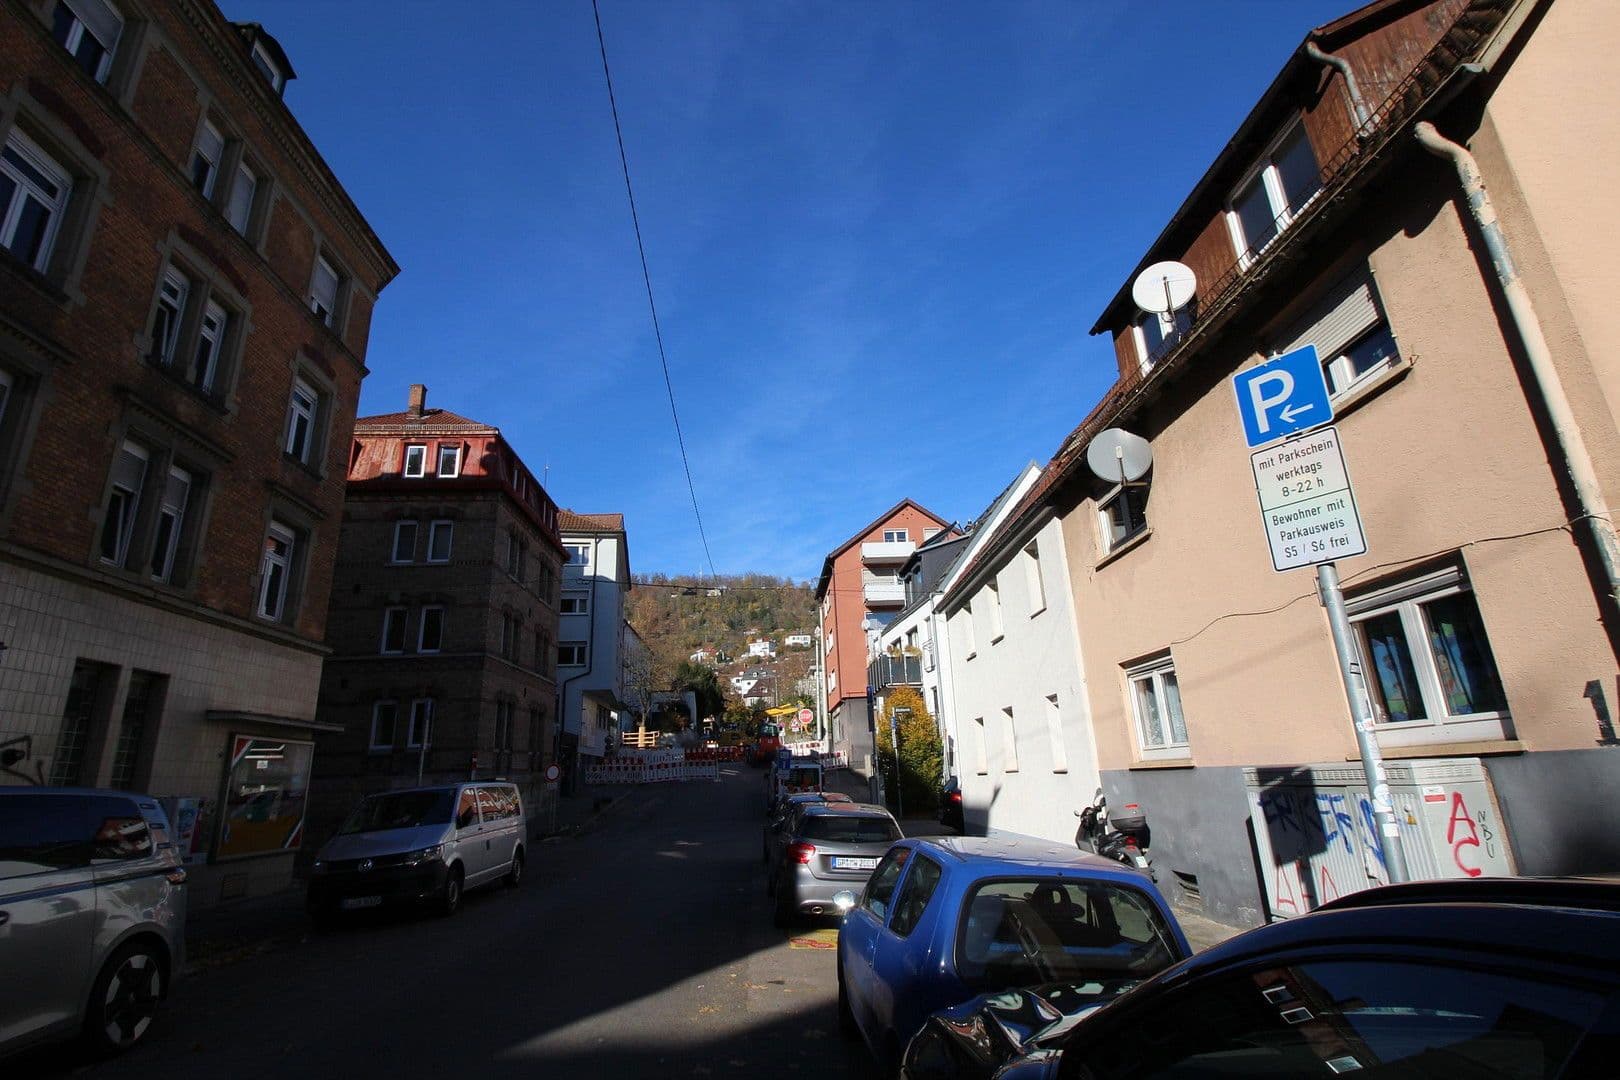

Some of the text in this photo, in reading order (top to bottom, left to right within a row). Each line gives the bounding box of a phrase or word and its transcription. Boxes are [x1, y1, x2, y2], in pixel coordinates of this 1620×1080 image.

[1248, 369, 1295, 434] P
[1258, 439, 1334, 471] mit Parkschein
[1275, 461, 1323, 482] werktags
[1281, 477, 1324, 497] 8-22 h
[1272, 499, 1346, 526] Bewohner mit
[1279, 518, 1345, 542] Parkausweis
[1284, 545, 1298, 558] S5
[1311, 539, 1325, 552] S6
[1330, 536, 1350, 549] frei
